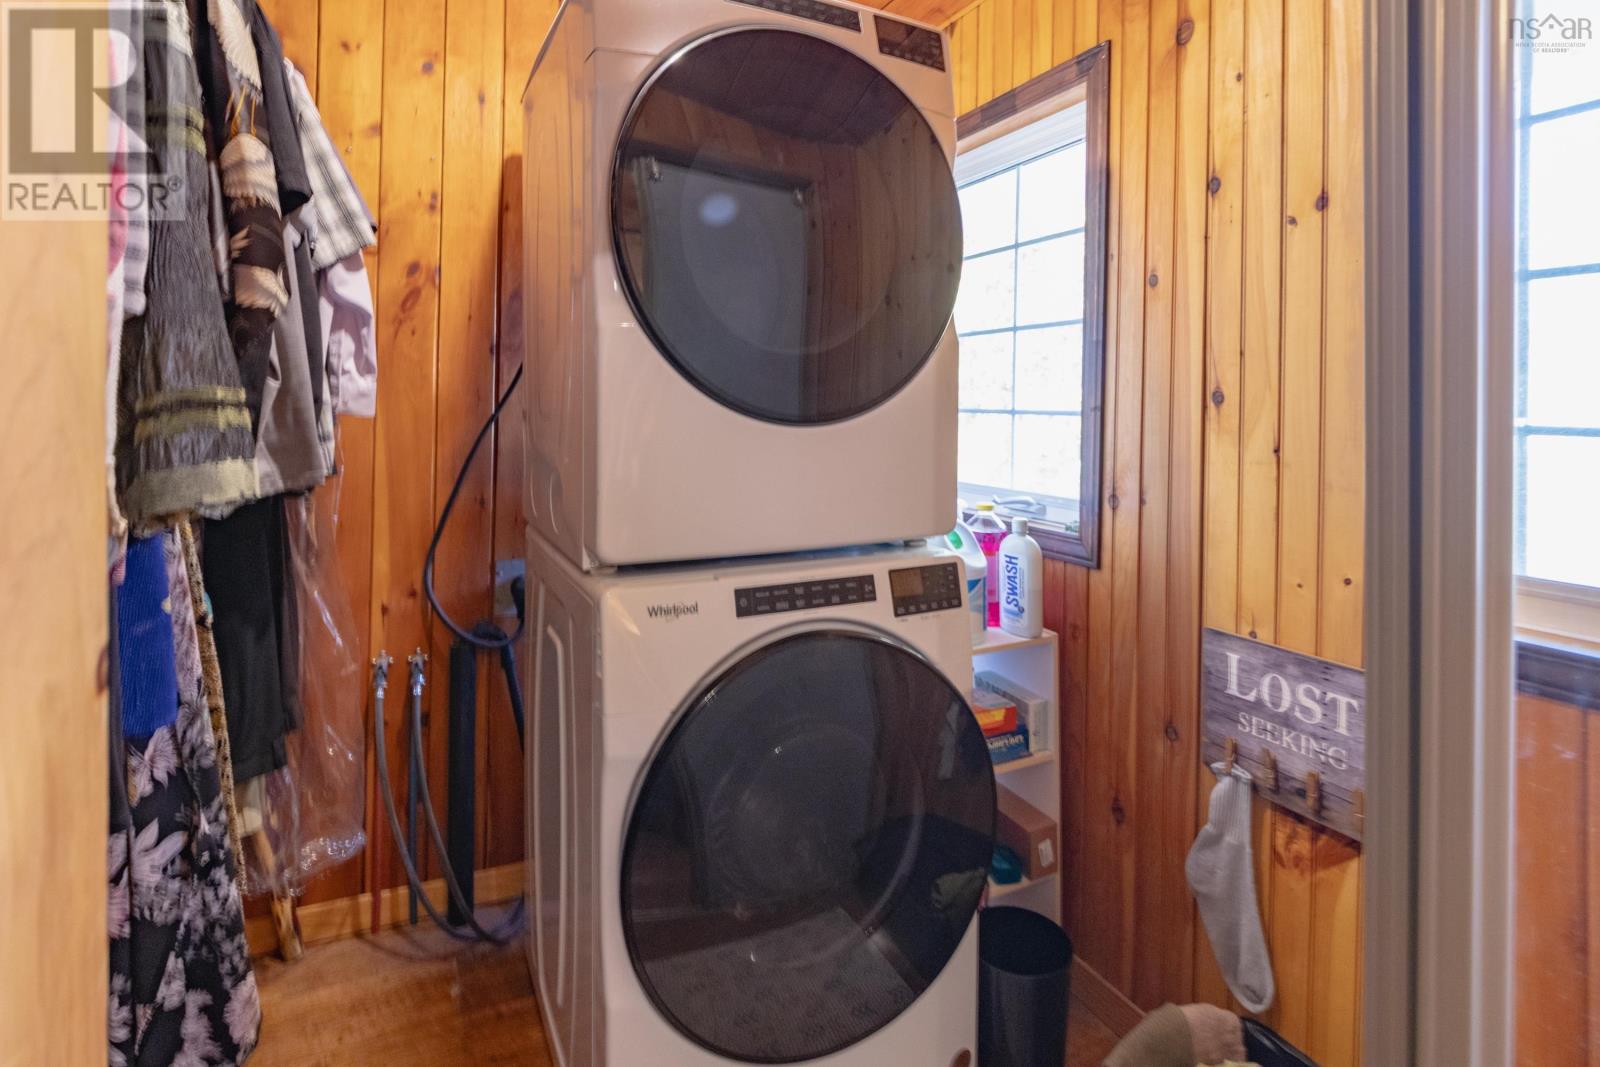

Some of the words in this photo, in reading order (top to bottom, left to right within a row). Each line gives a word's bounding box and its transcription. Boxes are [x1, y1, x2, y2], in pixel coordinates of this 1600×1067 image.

[1004, 554, 1020, 608] SWASH
[647, 601, 699, 619] Whirlpool
[1224, 652, 1360, 737] LOST
[1238, 712, 1348, 771] SEEKING
